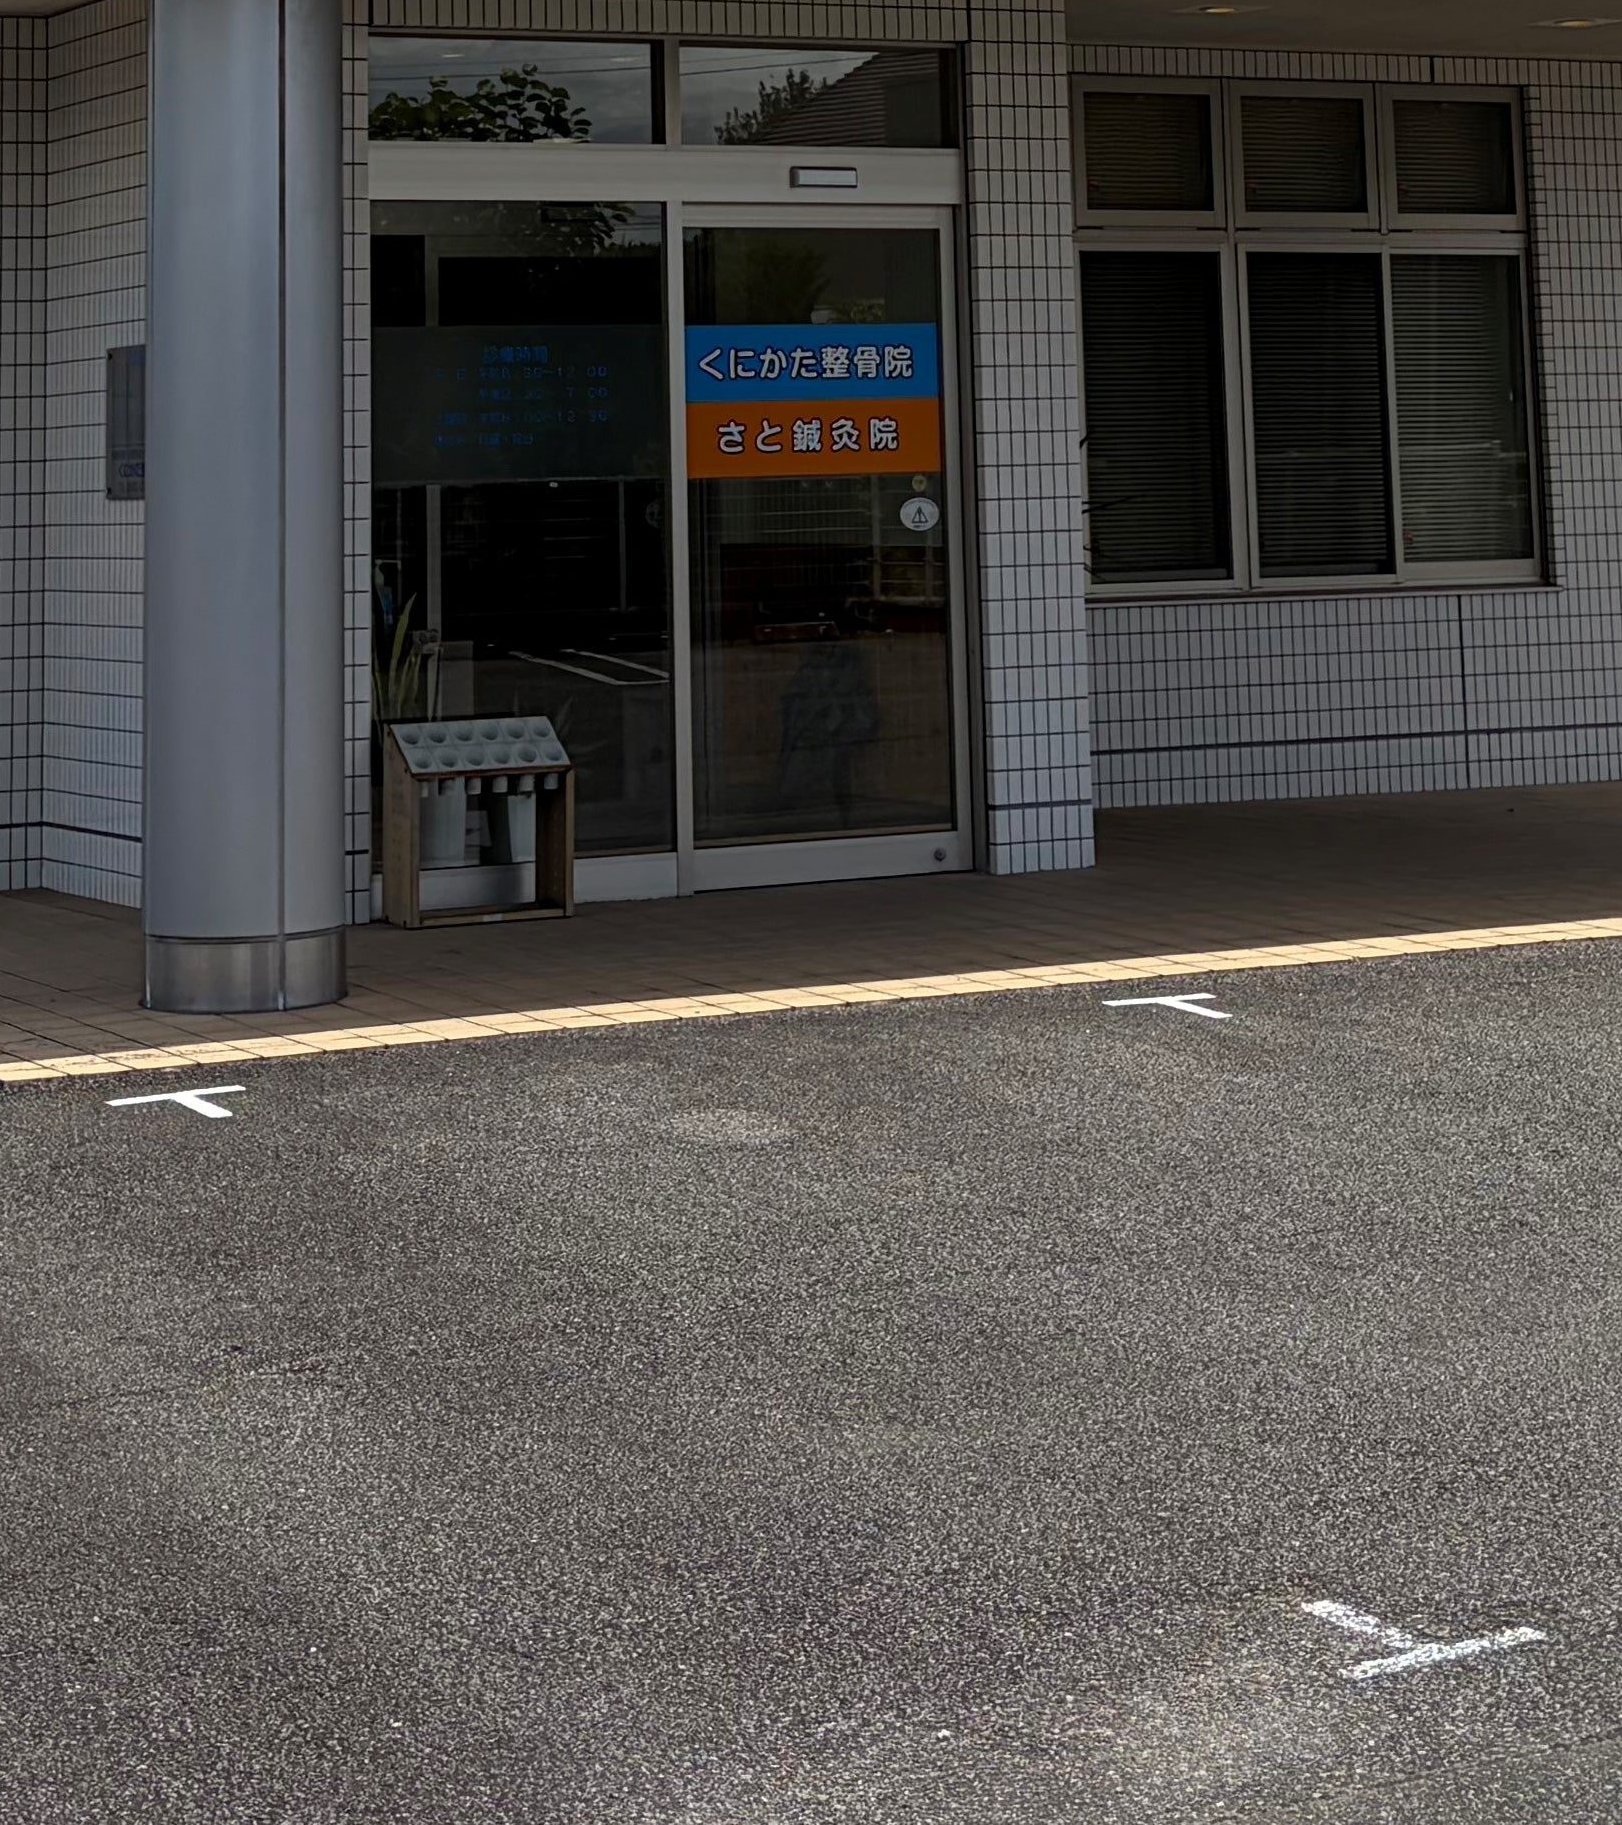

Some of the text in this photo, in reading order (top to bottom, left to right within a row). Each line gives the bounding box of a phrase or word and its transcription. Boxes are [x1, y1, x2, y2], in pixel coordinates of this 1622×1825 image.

[699, 346, 913, 380] くにかた整骨院
[718, 418, 899, 453] さと鍼灸院
